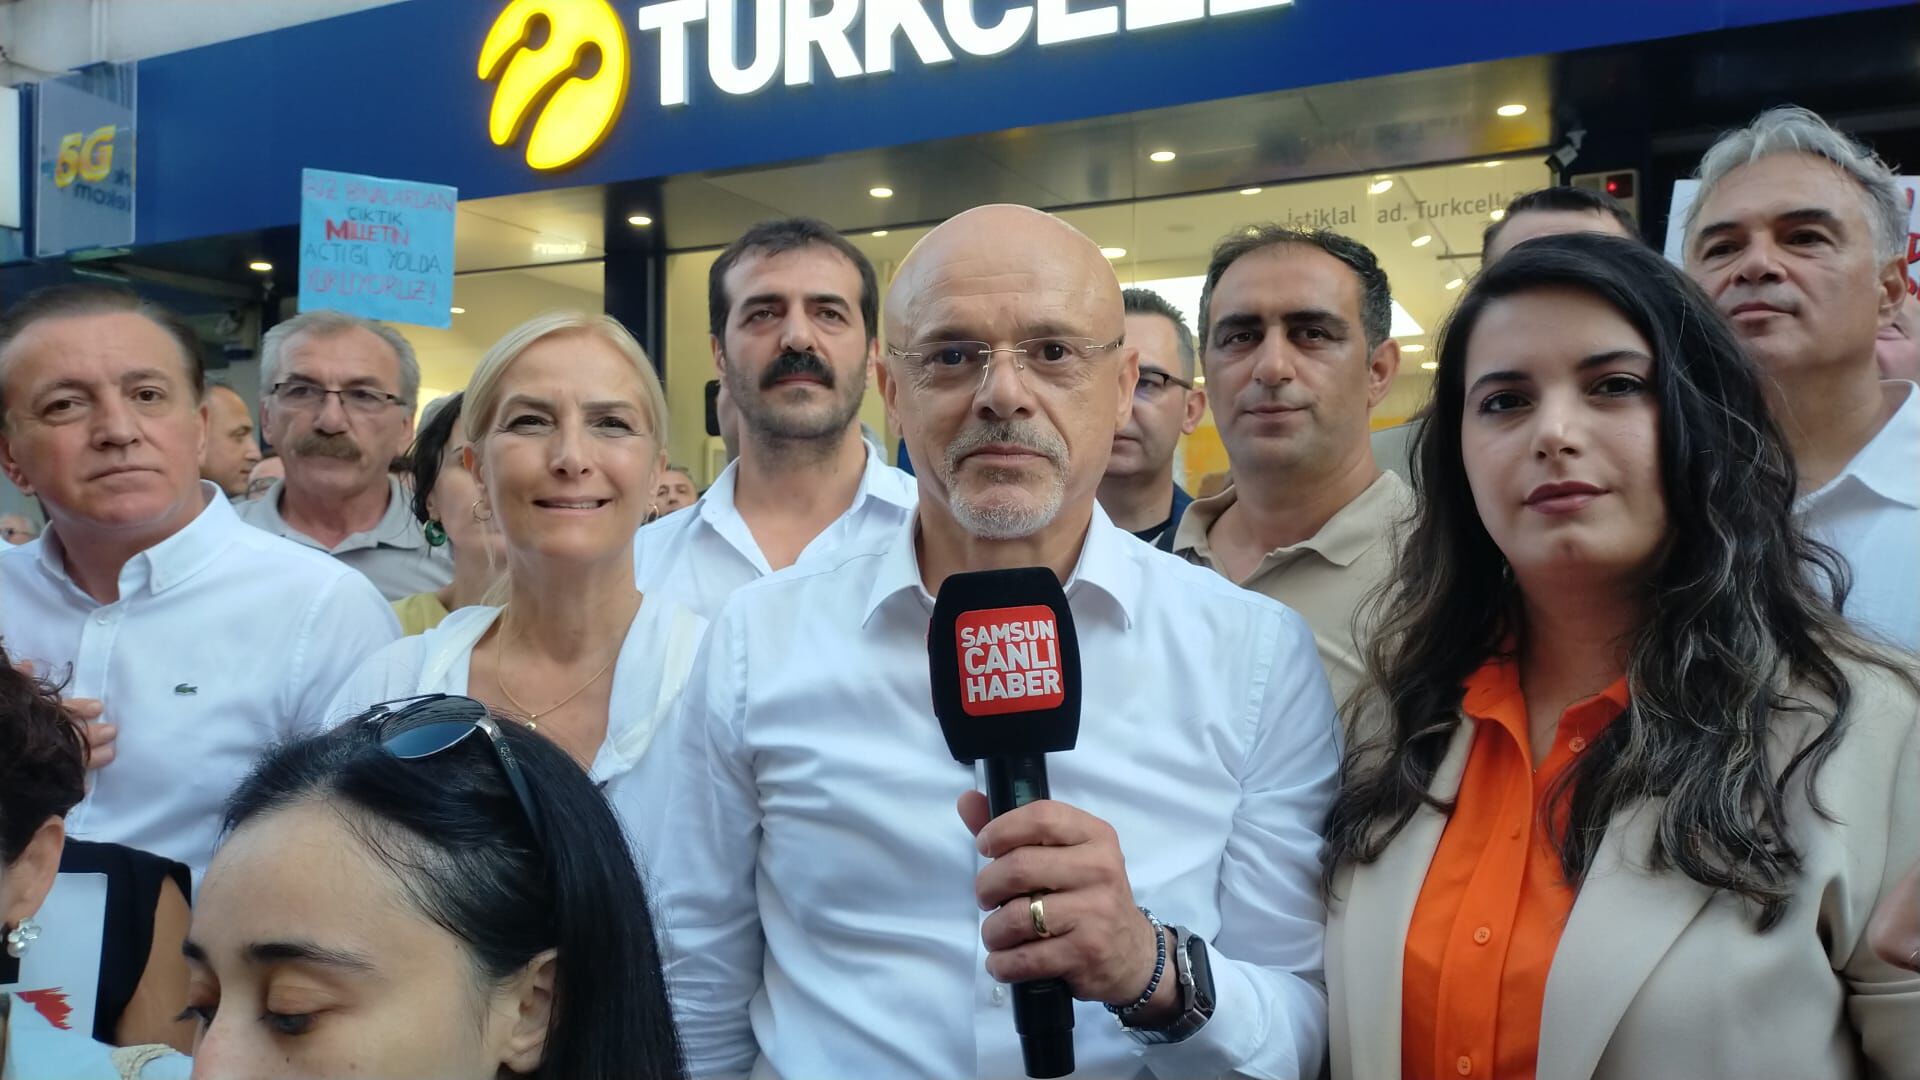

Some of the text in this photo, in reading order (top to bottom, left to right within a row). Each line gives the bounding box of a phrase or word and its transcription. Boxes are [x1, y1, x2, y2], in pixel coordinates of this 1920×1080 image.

[638, 0, 1294, 106] TURKC
[1417, 191, 1501, 219] Turkcell
[386, 249, 442, 275] YOLDA
[960, 619, 1055, 648] SAMSUN
[964, 640, 1057, 676] CANLI
[966, 669, 1062, 703] HABER
